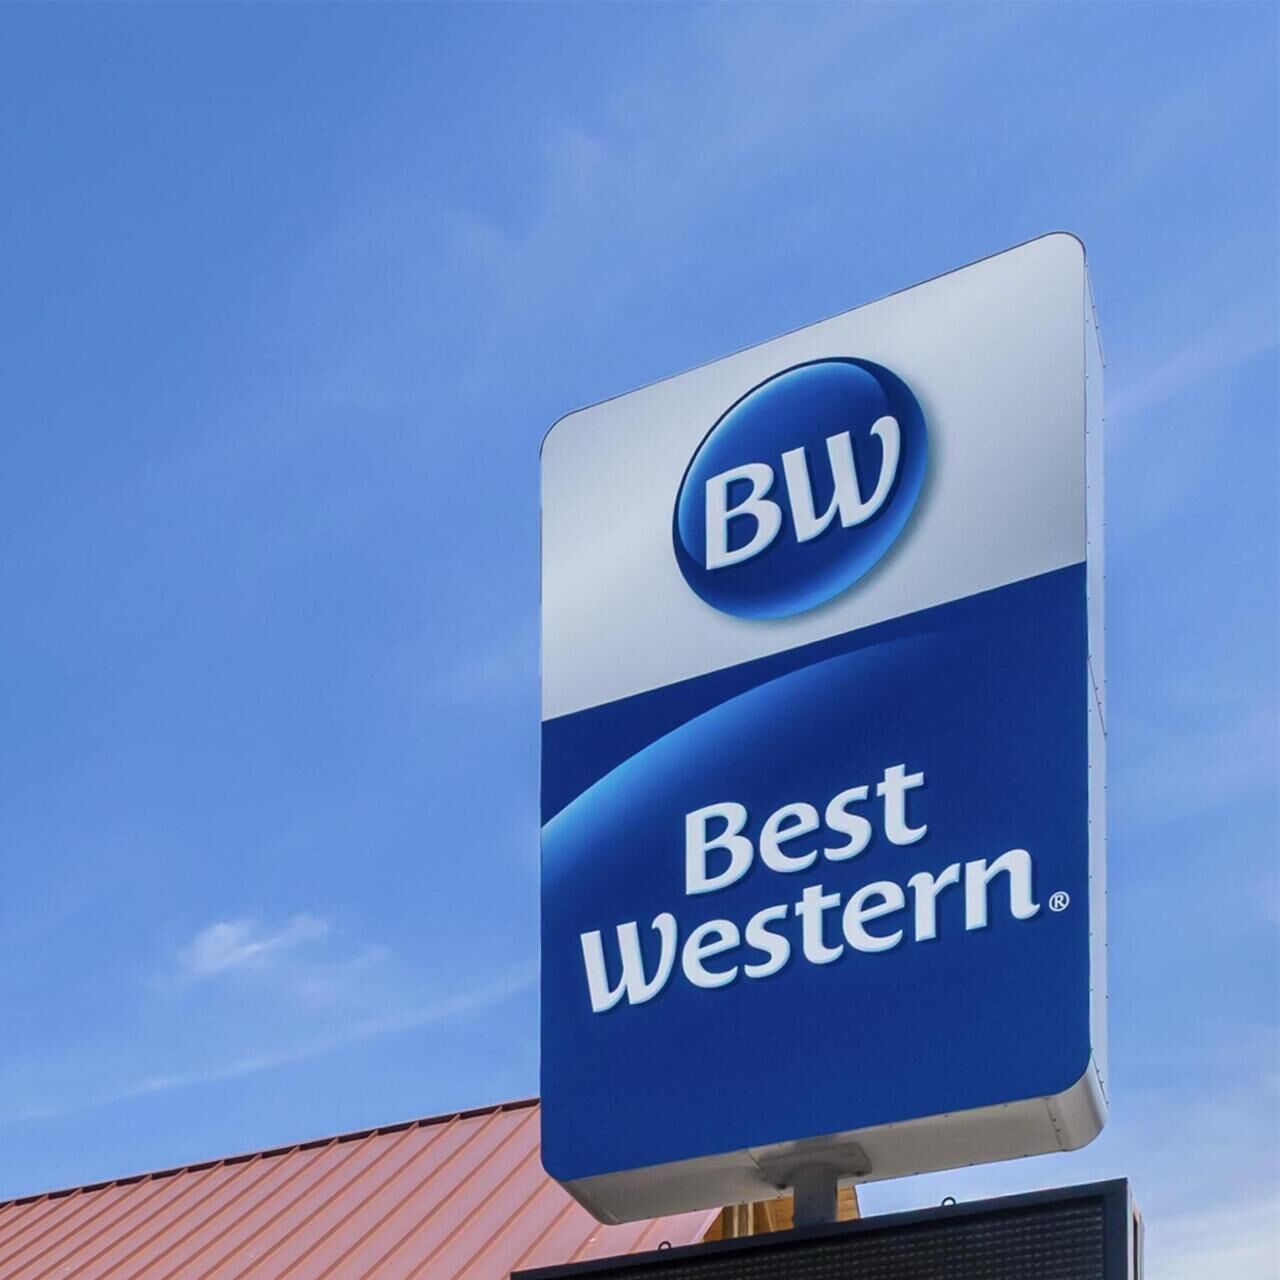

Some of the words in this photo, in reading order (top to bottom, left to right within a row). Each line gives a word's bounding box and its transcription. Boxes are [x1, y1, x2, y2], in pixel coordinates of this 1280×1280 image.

[705, 415, 900, 570] BW
[685, 763, 927, 895] Best
[580, 847, 1041, 1013] Western
